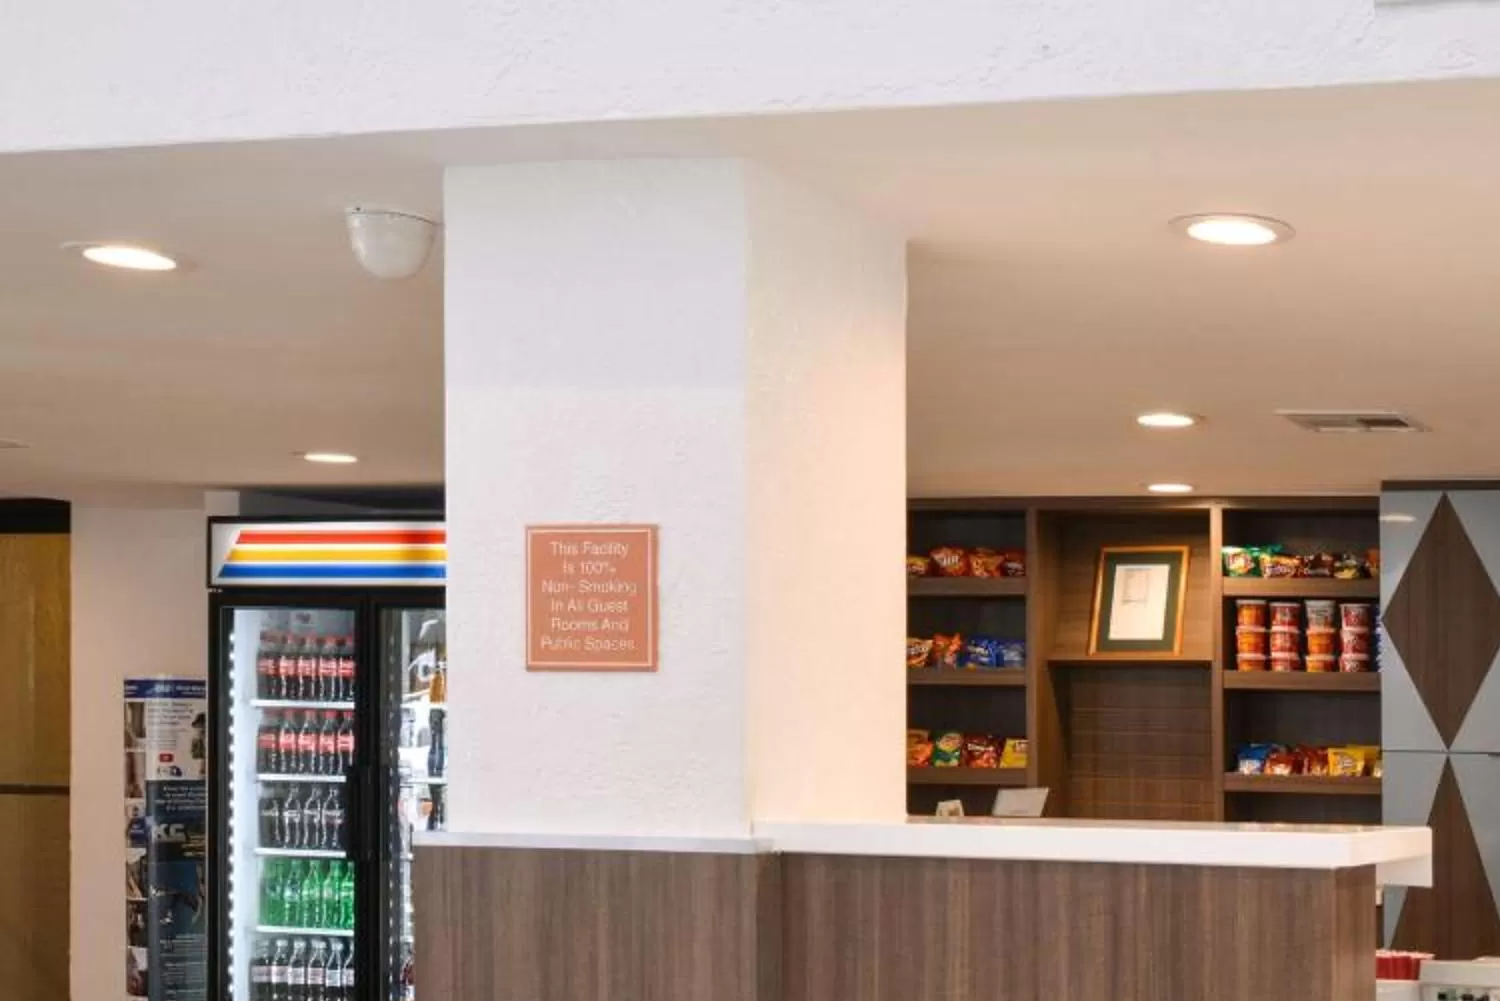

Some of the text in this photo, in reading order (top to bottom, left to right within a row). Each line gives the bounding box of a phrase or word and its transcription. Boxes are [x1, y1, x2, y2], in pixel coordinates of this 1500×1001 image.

[550, 541, 629, 558] This Facility
[580, 561, 616, 574] 100%
[578, 580, 637, 596] Smoking
[551, 599, 629, 613] In All Guest
[551, 617, 629, 632] Rooms And
[540, 636, 582, 650] Public
